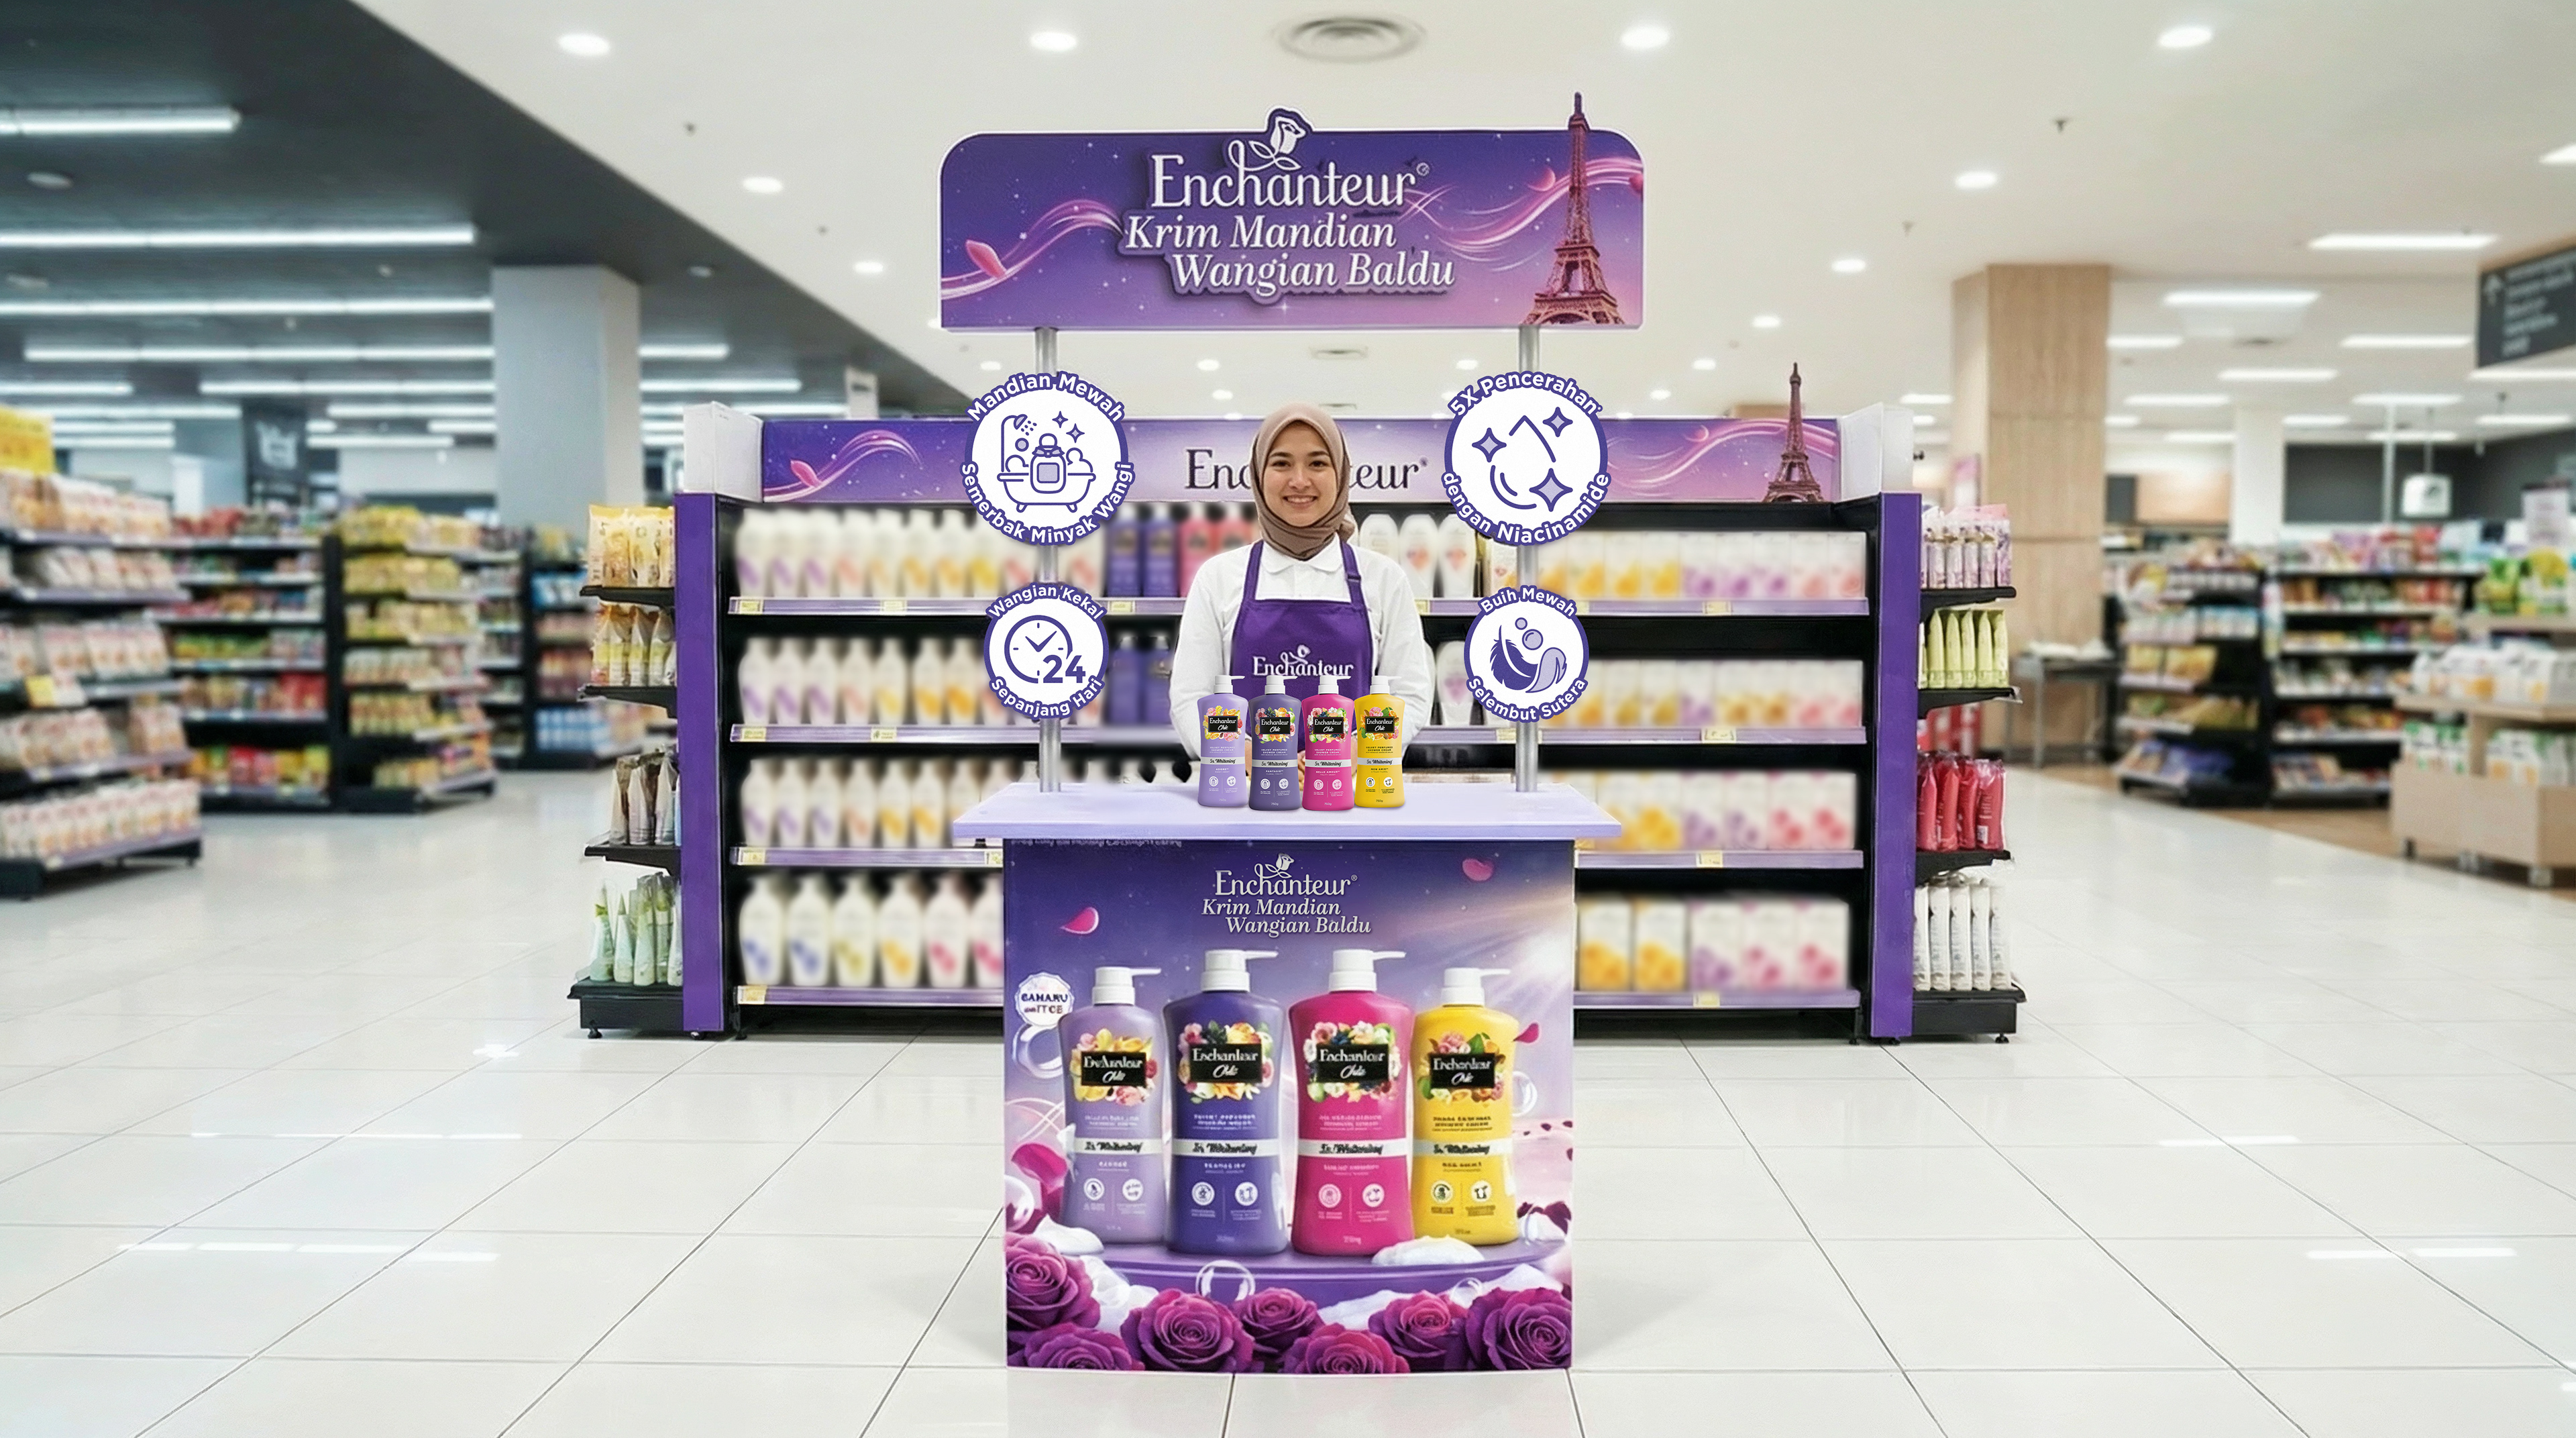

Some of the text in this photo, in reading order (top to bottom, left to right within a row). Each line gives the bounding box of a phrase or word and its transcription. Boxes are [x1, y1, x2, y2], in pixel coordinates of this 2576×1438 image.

[1126, 213, 1397, 249] Krim Mandian
[1173, 250, 1455, 297] Wangian Baldu
[967, 373, 1125, 422] Mandian Mewah
[1450, 389, 1479, 416] 5X
[1185, 448, 1420, 490] Enceur
[962, 463, 1133, 544] Semerbak Minyak Wangi
[1443, 472, 1609, 544] dengan Niacinamide
[988, 584, 1104, 619] Wangian Kekal
[1480, 587, 1575, 617] Buih Mewah
[1042, 654, 1086, 683] 24
[1252, 652, 1354, 676] Enchanteur
[991, 678, 1103, 718] Sepanjang Hari
[1468, 678, 1586, 721] Selembut Sutera
[1201, 898, 1341, 915] Krim Mandian
[1225, 916, 1371, 938] Wangian Baldu
